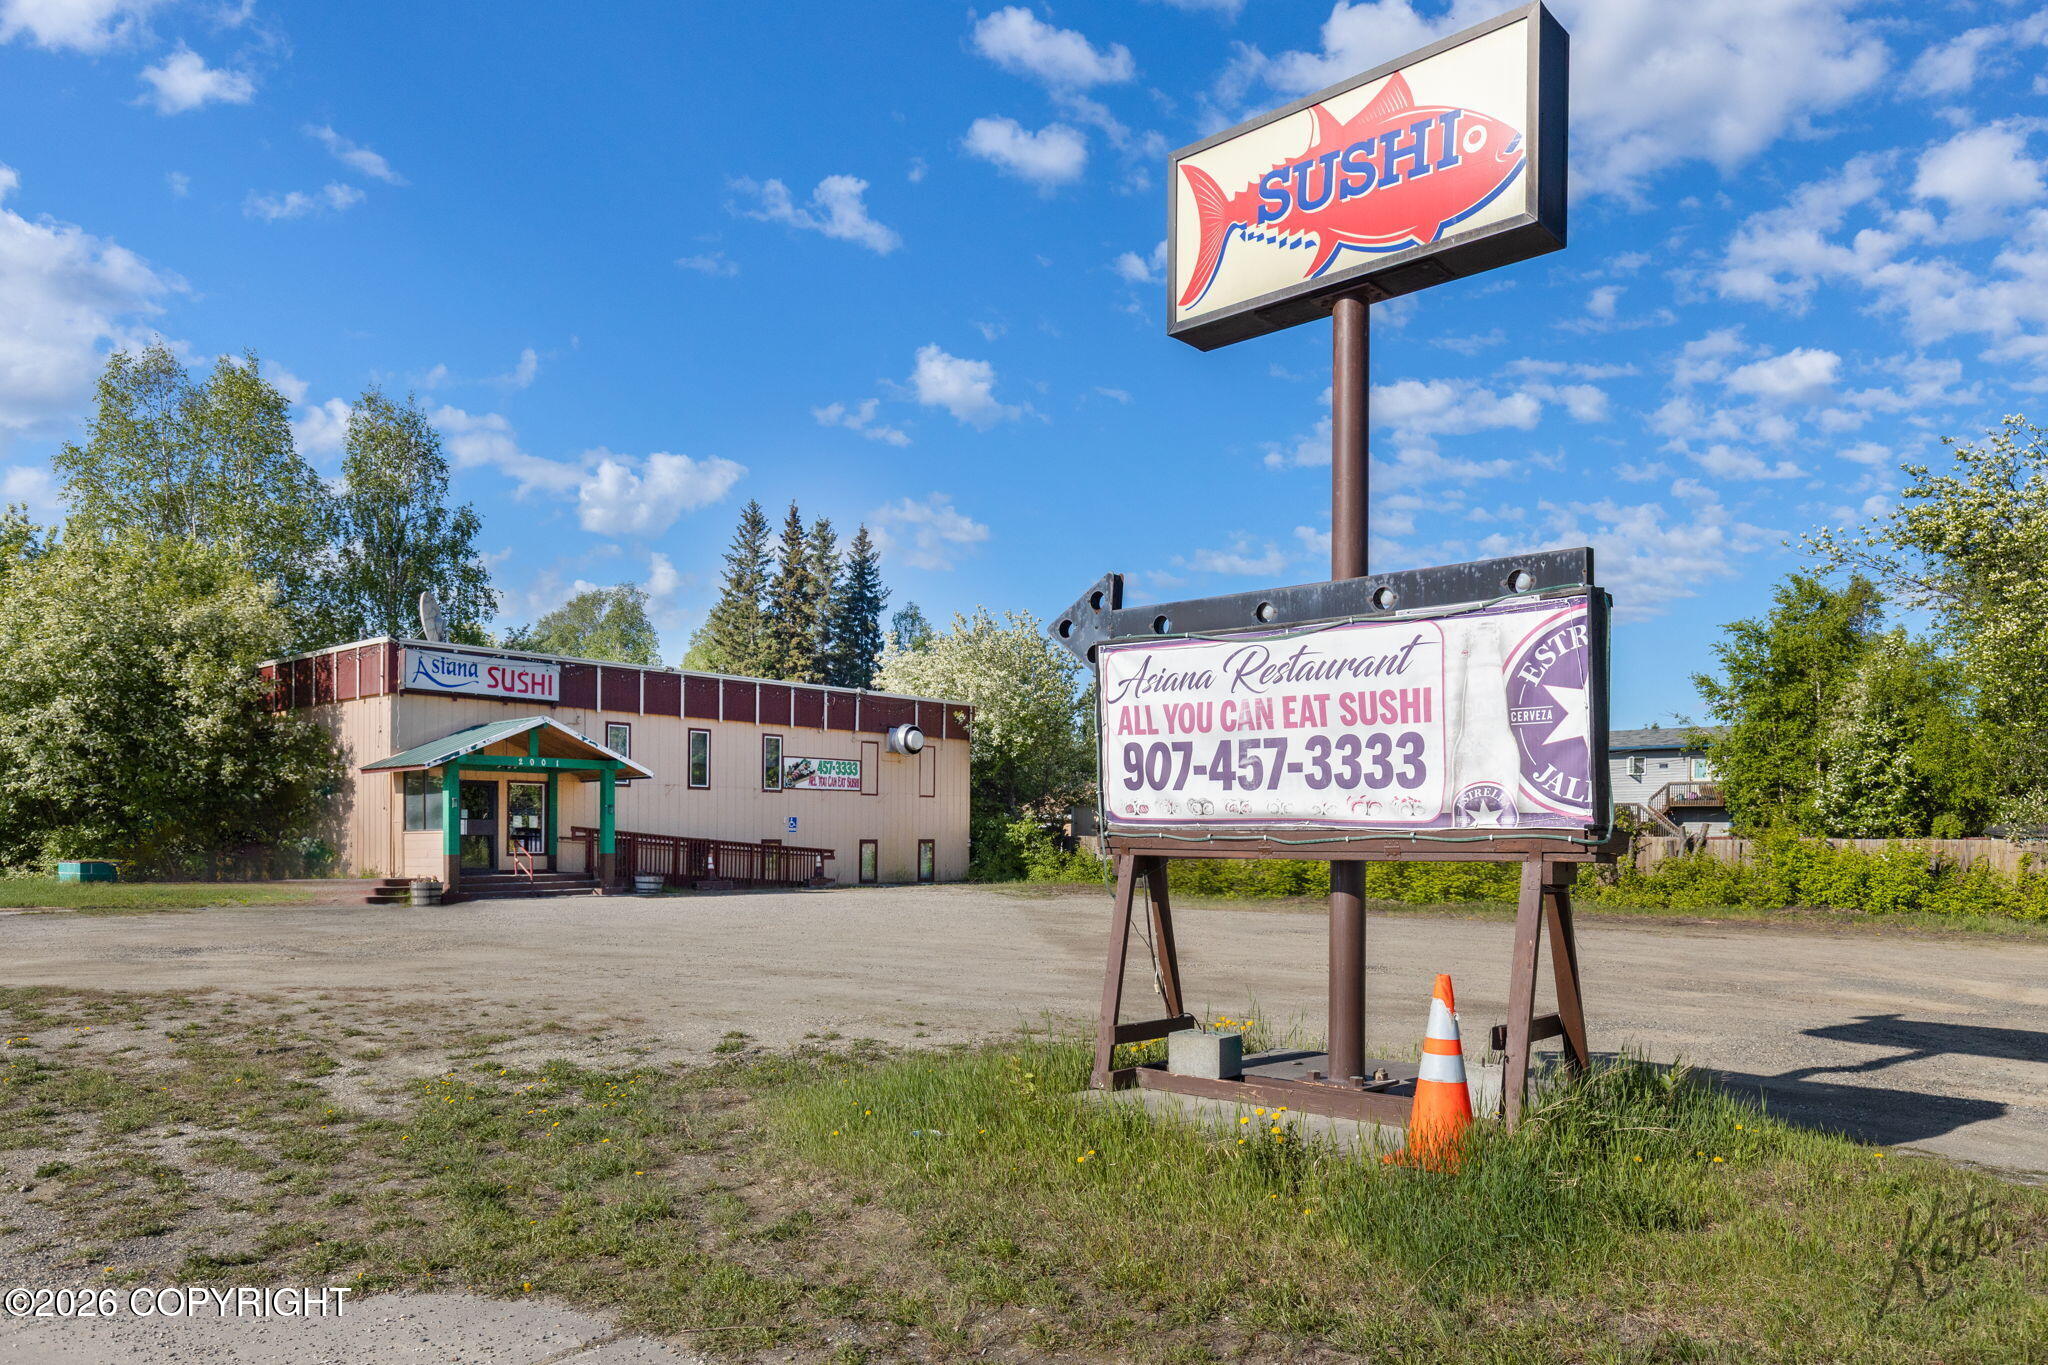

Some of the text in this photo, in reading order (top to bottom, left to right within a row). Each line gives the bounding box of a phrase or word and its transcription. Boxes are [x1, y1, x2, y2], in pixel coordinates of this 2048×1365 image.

[1258, 110, 1464, 225] SUSHI
[412, 655, 552, 696] Asiana SUSHI
[1107, 634, 1440, 704] Asiana Restaurant
[1118, 687, 1432, 735] ALL YOU CAN EAT SUSHI
[1510, 709, 1553, 722] CERVEZA
[817, 760, 859, 776] 457-3333
[1123, 732, 1427, 791] 907-457-3333
